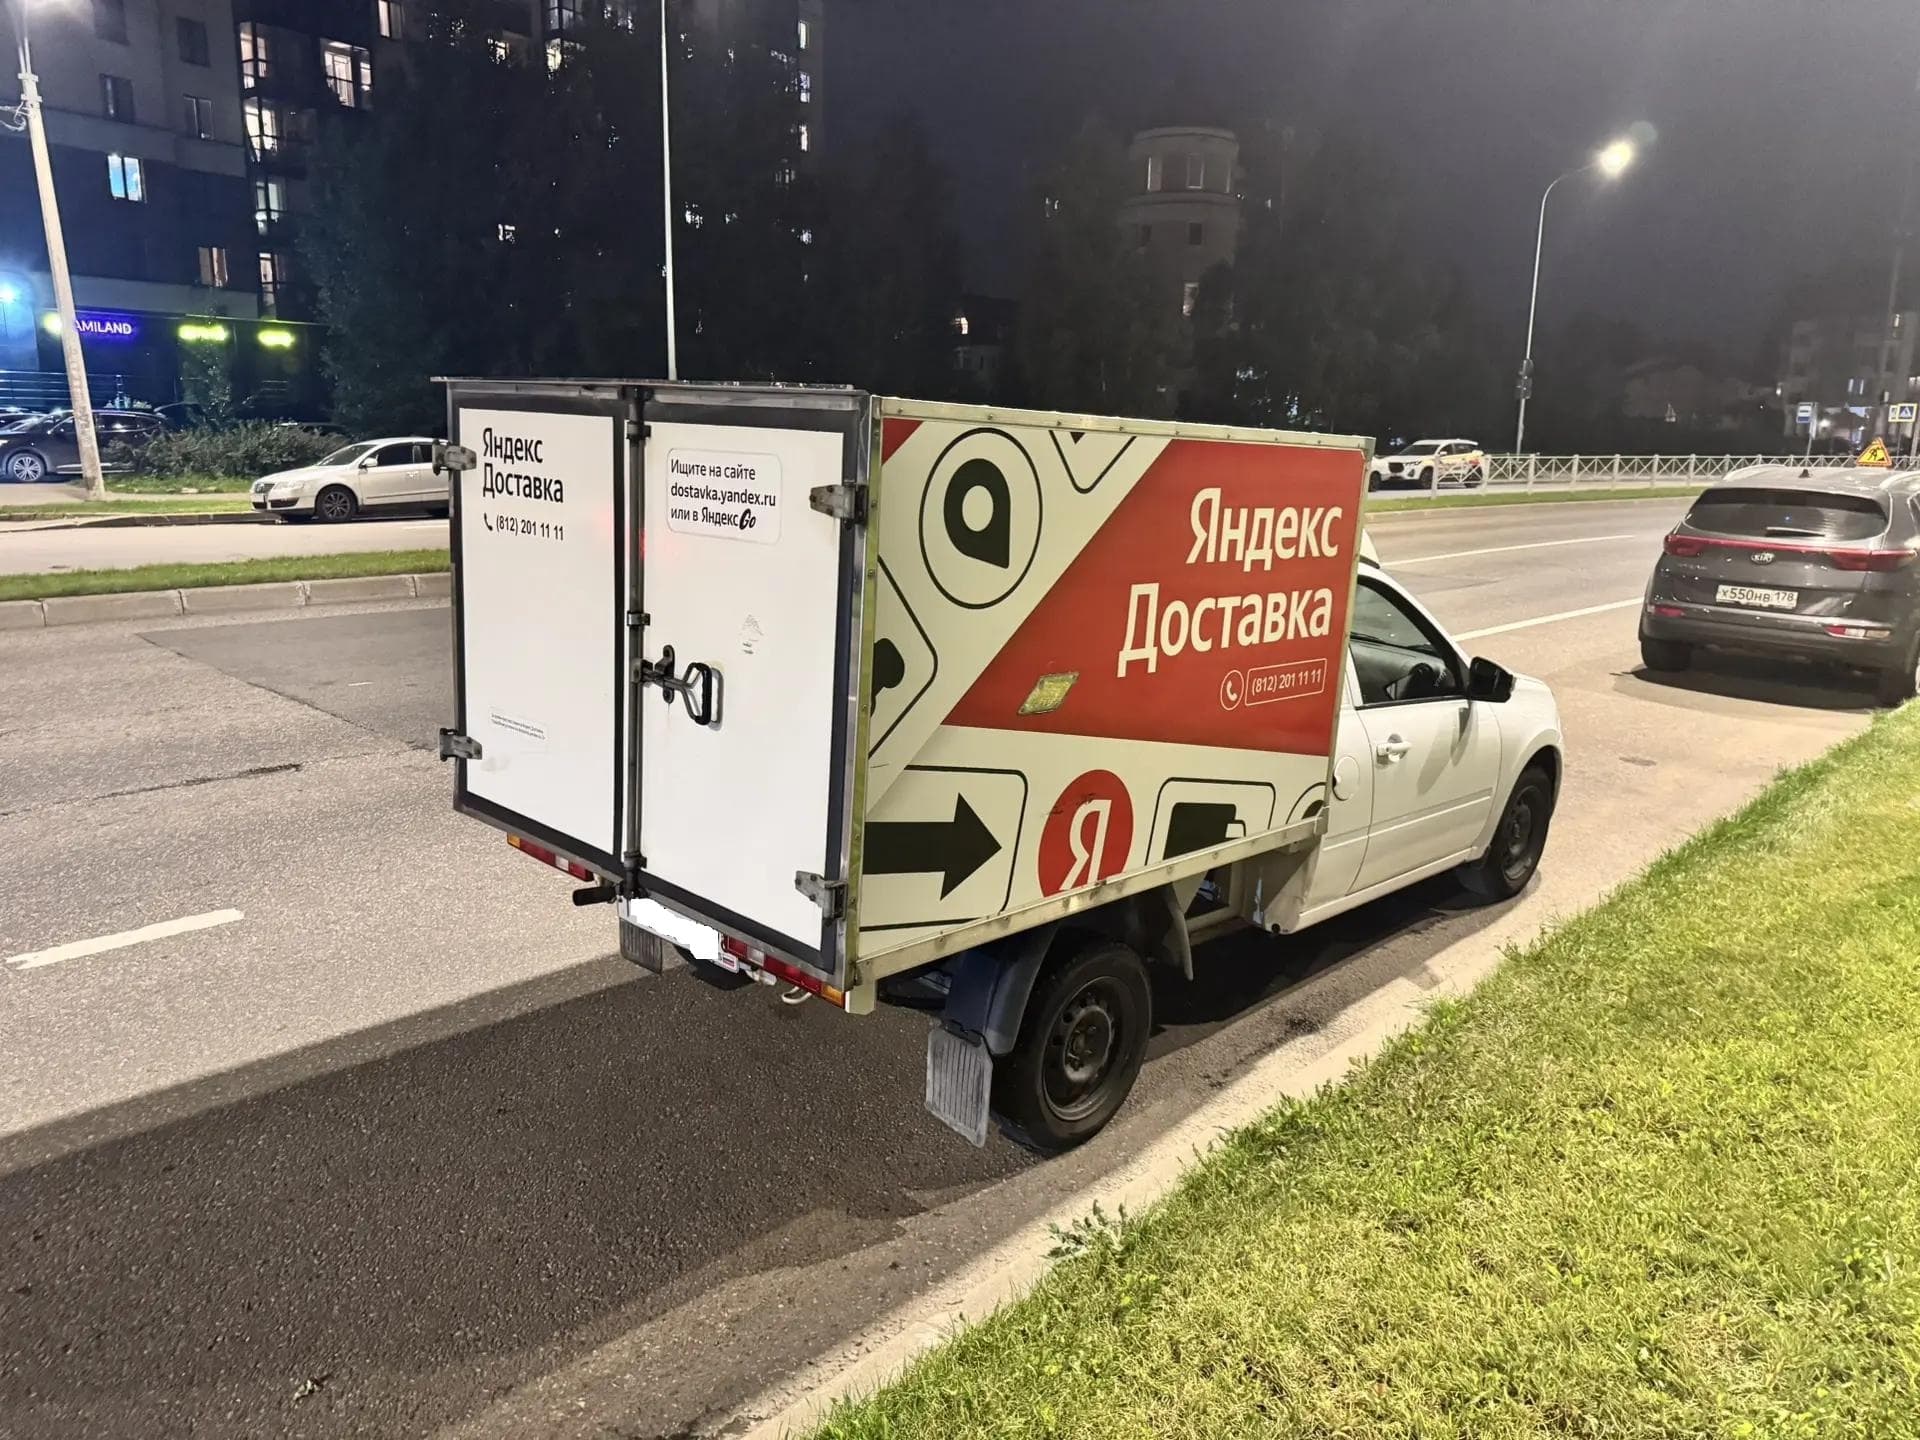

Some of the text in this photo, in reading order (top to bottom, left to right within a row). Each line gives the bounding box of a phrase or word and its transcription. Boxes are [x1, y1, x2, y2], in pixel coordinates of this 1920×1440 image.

[75, 319, 132, 335] AMILAND
[483, 427, 543, 464] Яндекс
[483, 462, 564, 503] Доставка
[671, 458, 756, 480] Ищите на сайте
[671, 481, 776, 507] dostavka.yandex.ru
[496, 514, 564, 541] (812) 201 11 11
[671, 507, 690, 521] или
[692, 509, 699, 522] в
[1185, 487, 1343, 573] Яндекс
[1116, 582, 1334, 678] Доставка
[1251, 668, 1322, 696] (812) 201 11 11
[1059, 799, 1112, 891] Я
